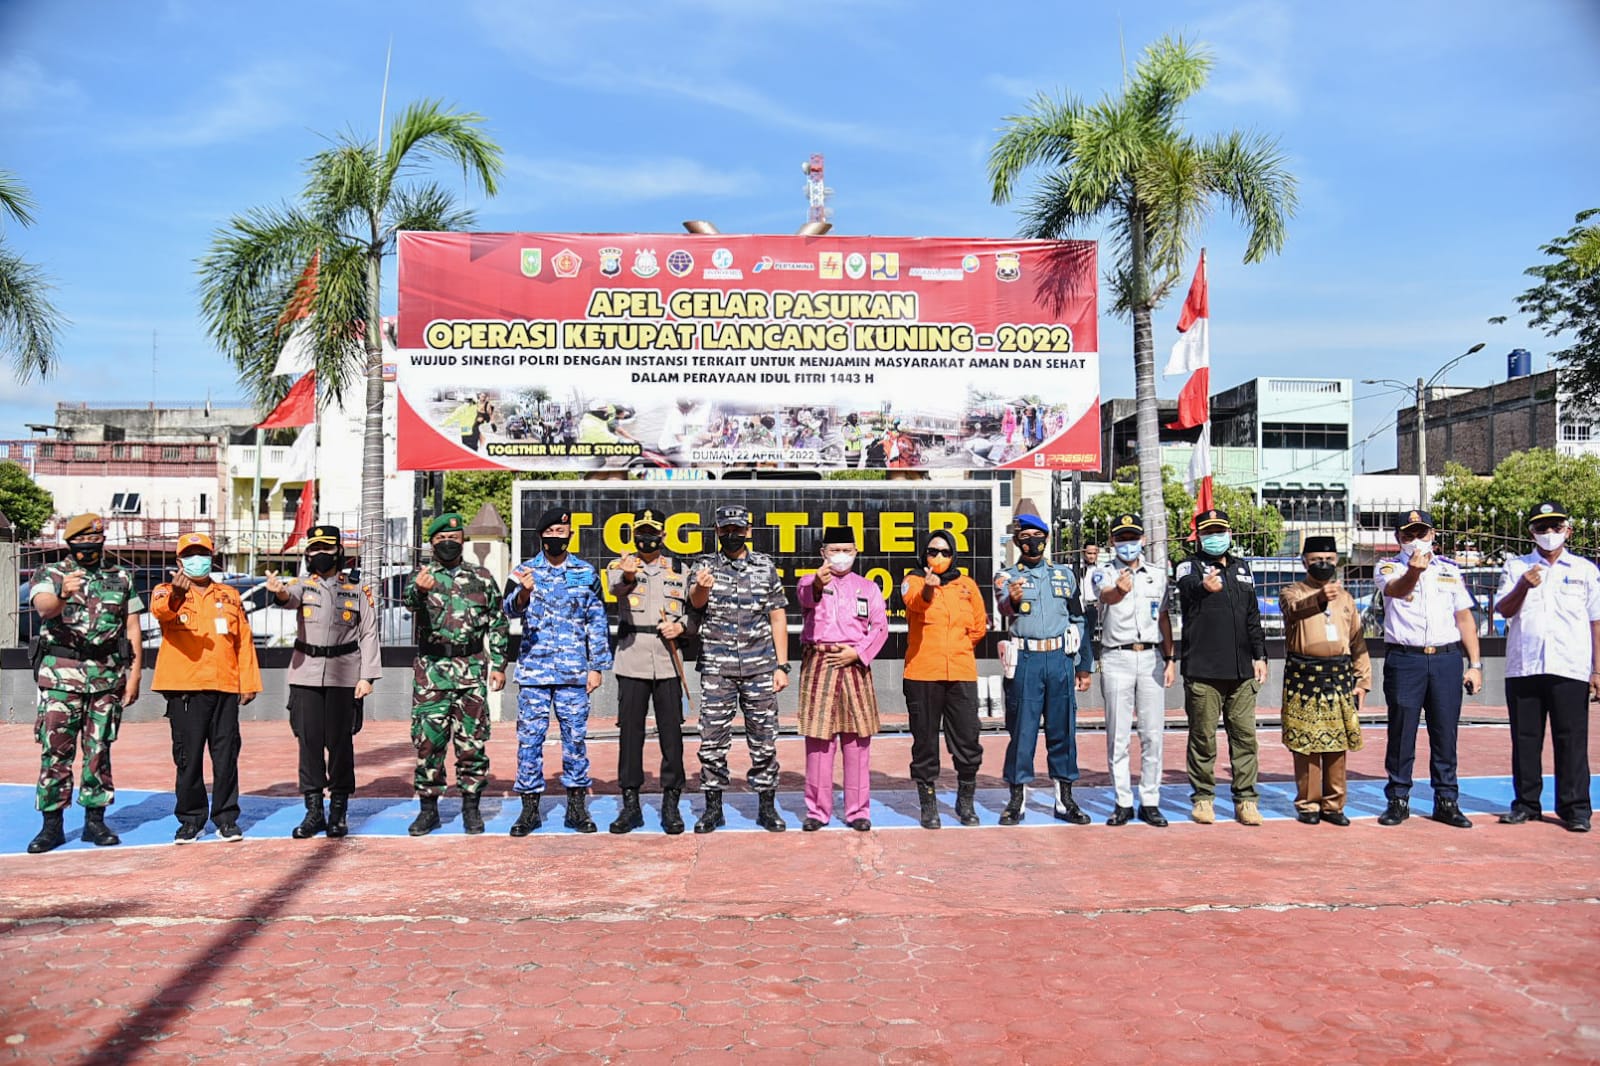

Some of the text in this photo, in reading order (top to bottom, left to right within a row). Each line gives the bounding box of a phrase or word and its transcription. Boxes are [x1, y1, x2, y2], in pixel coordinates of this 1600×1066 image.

[589, 290, 916, 319] APEL GELAR PASUKAN
[427, 322, 557, 349] OPERASI
[564, 323, 697, 349] KETUPAT
[702, 324, 848, 350] LANCANG
[854, 325, 973, 352] KUNING
[997, 326, 1070, 352] 2022
[411, 355, 1086, 369] WUJUD SINERGI POLRI DENGAN INSTANSI TERKAIT UNTUK MENJAMIN MASYARAKAT AMAN DAN SEHAT
[631, 372, 874, 384] DALAM PERAYAAN IDUL FITRI 1443 H
[488, 444, 641, 455] TOGETHER WE ARE STRONG
[692, 450, 815, 460] DUMAI, 22 APRIL 2022
